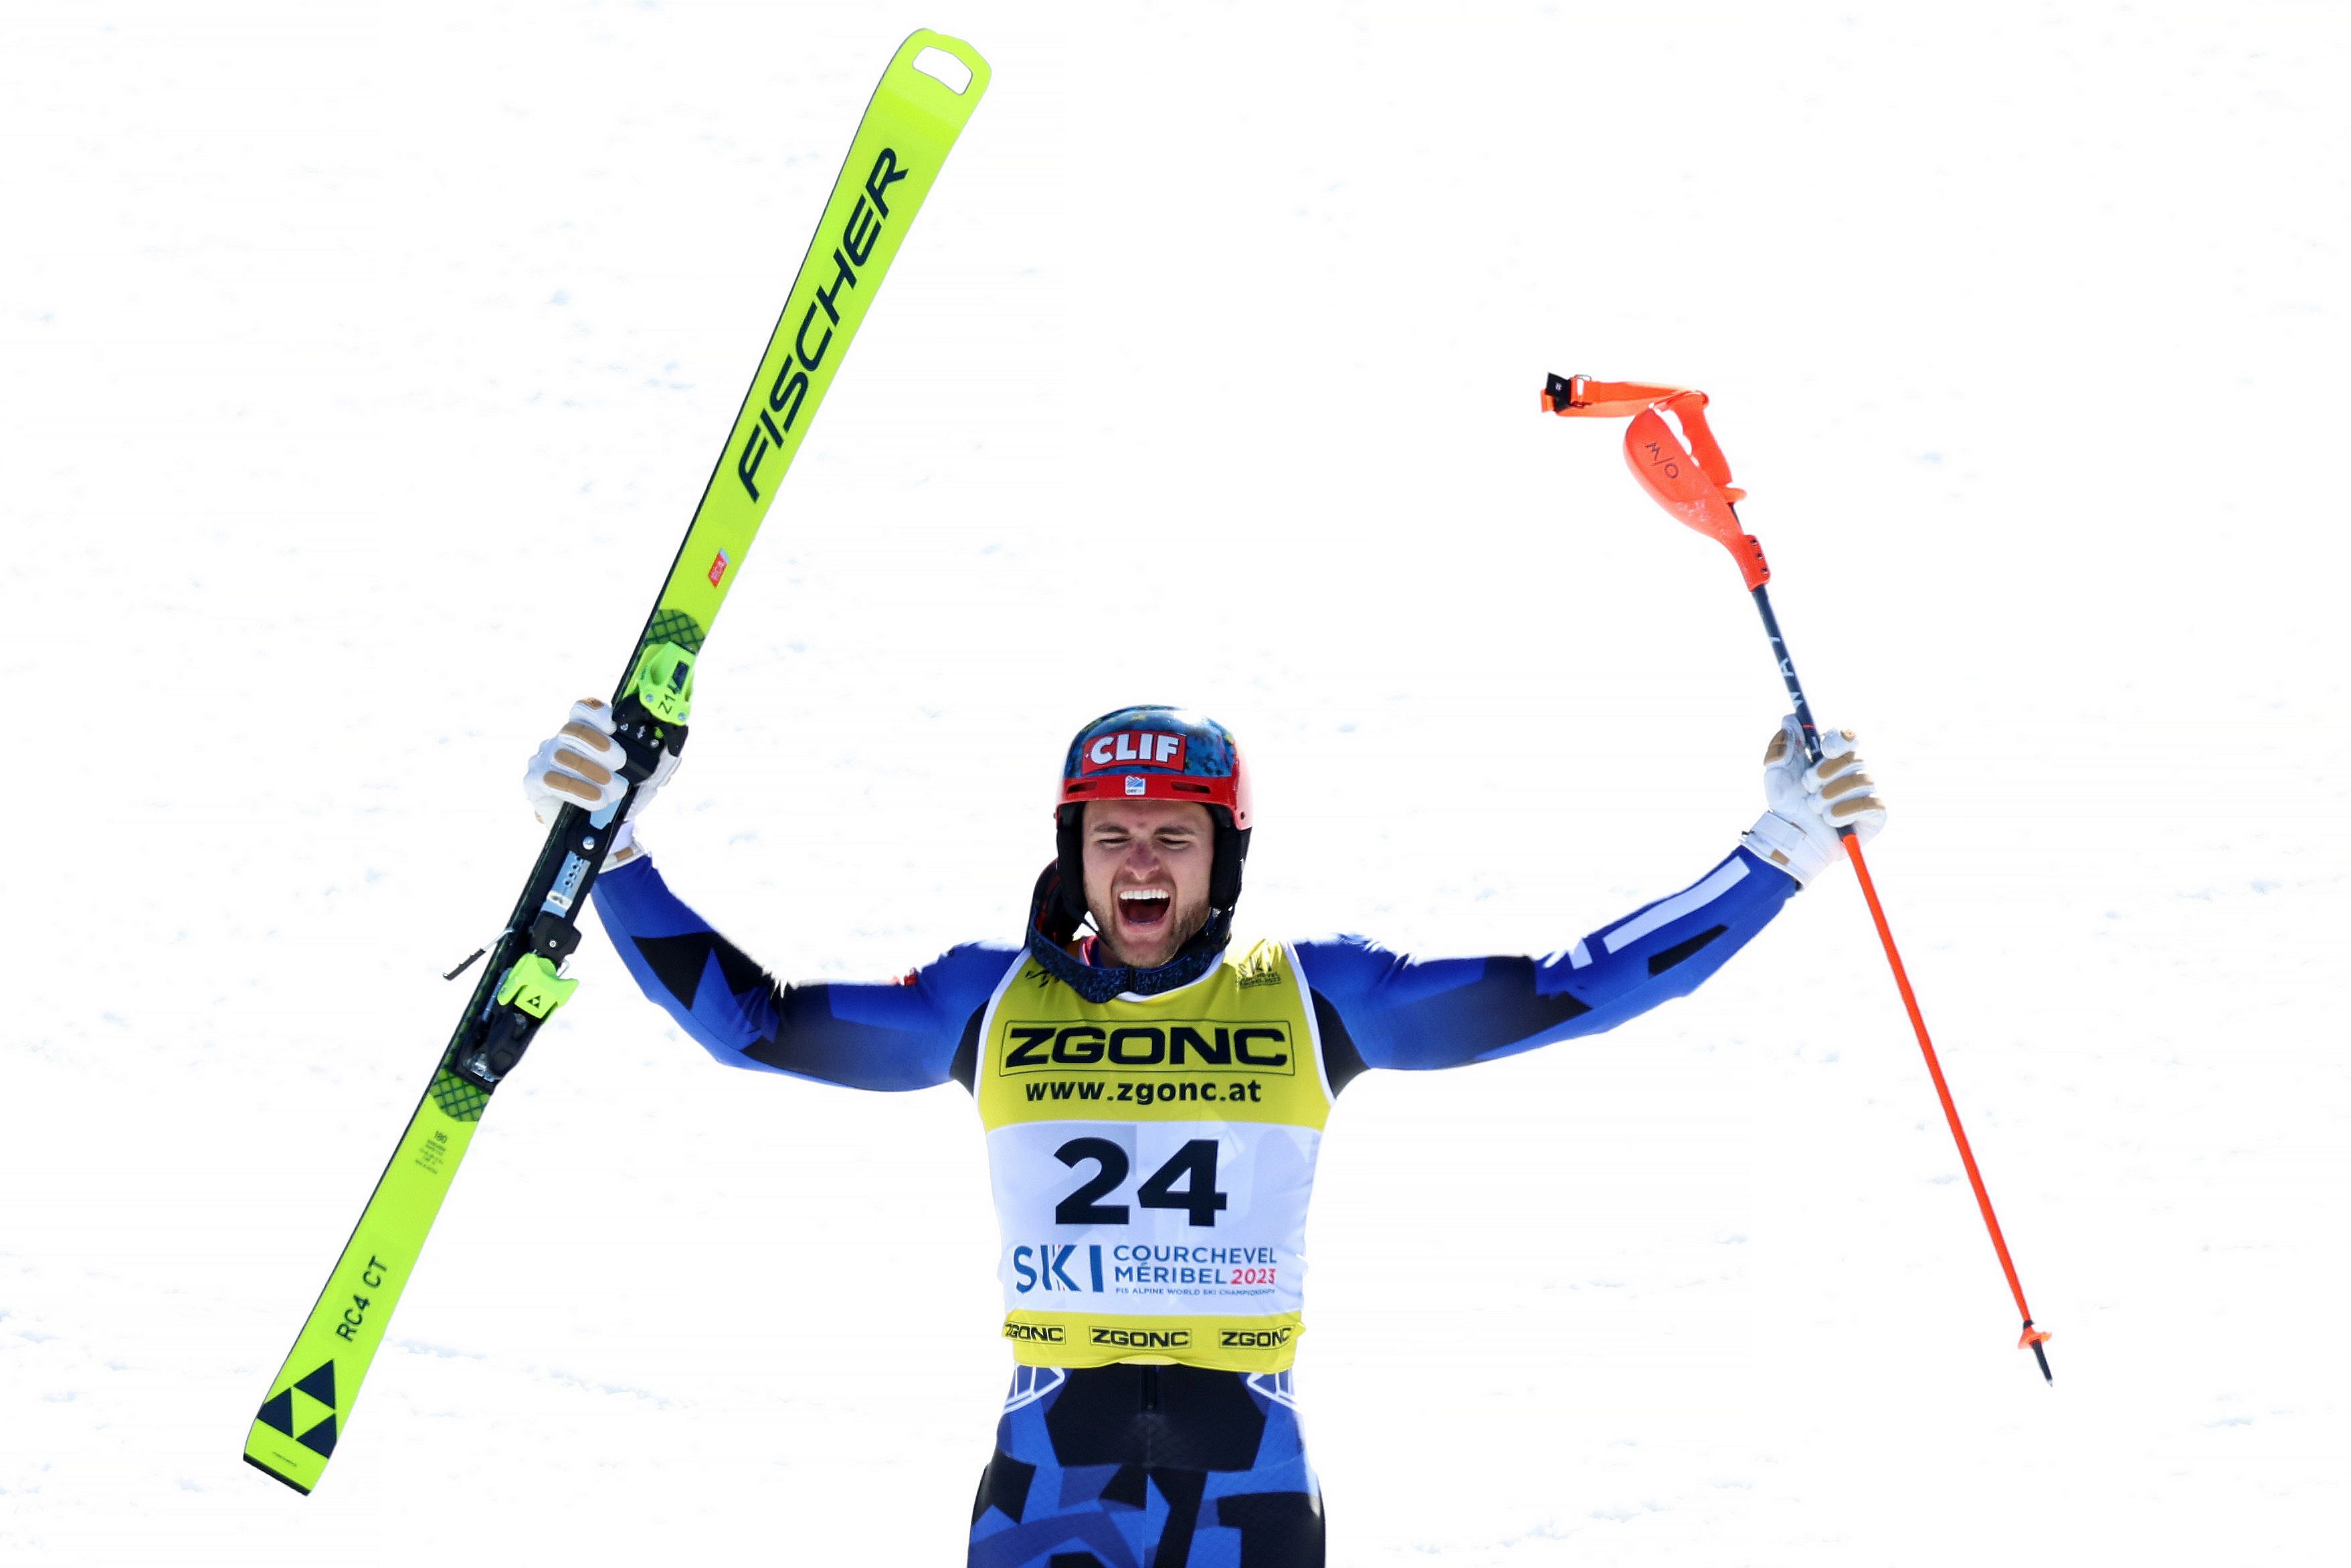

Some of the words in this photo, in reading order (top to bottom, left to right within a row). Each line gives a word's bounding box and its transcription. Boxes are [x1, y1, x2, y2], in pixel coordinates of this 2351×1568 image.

[738, 147, 909, 502] FISCHER
[1091, 733, 1180, 765] CLIF
[1006, 1027, 1287, 1068] ZGONC
[1026, 1080, 1261, 1106] www.zgonc.at
[1054, 1137, 1227, 1227] 24
[1113, 1245, 1277, 1264] COURCHEVEL
[1013, 1244, 1104, 1294] SKI
[1115, 1262, 1227, 1284] MÉRIBEL
[1230, 1268, 1276, 1284] 2023
[336, 1294, 371, 1342] RC4
[363, 1256, 387, 1288] CT
[1133, 1287, 1164, 1295] ALPINE
[1006, 1323, 1064, 1342] ZGONC
[1092, 1328, 1188, 1347] ZGONC
[1222, 1327, 1291, 1347] ZGONC
